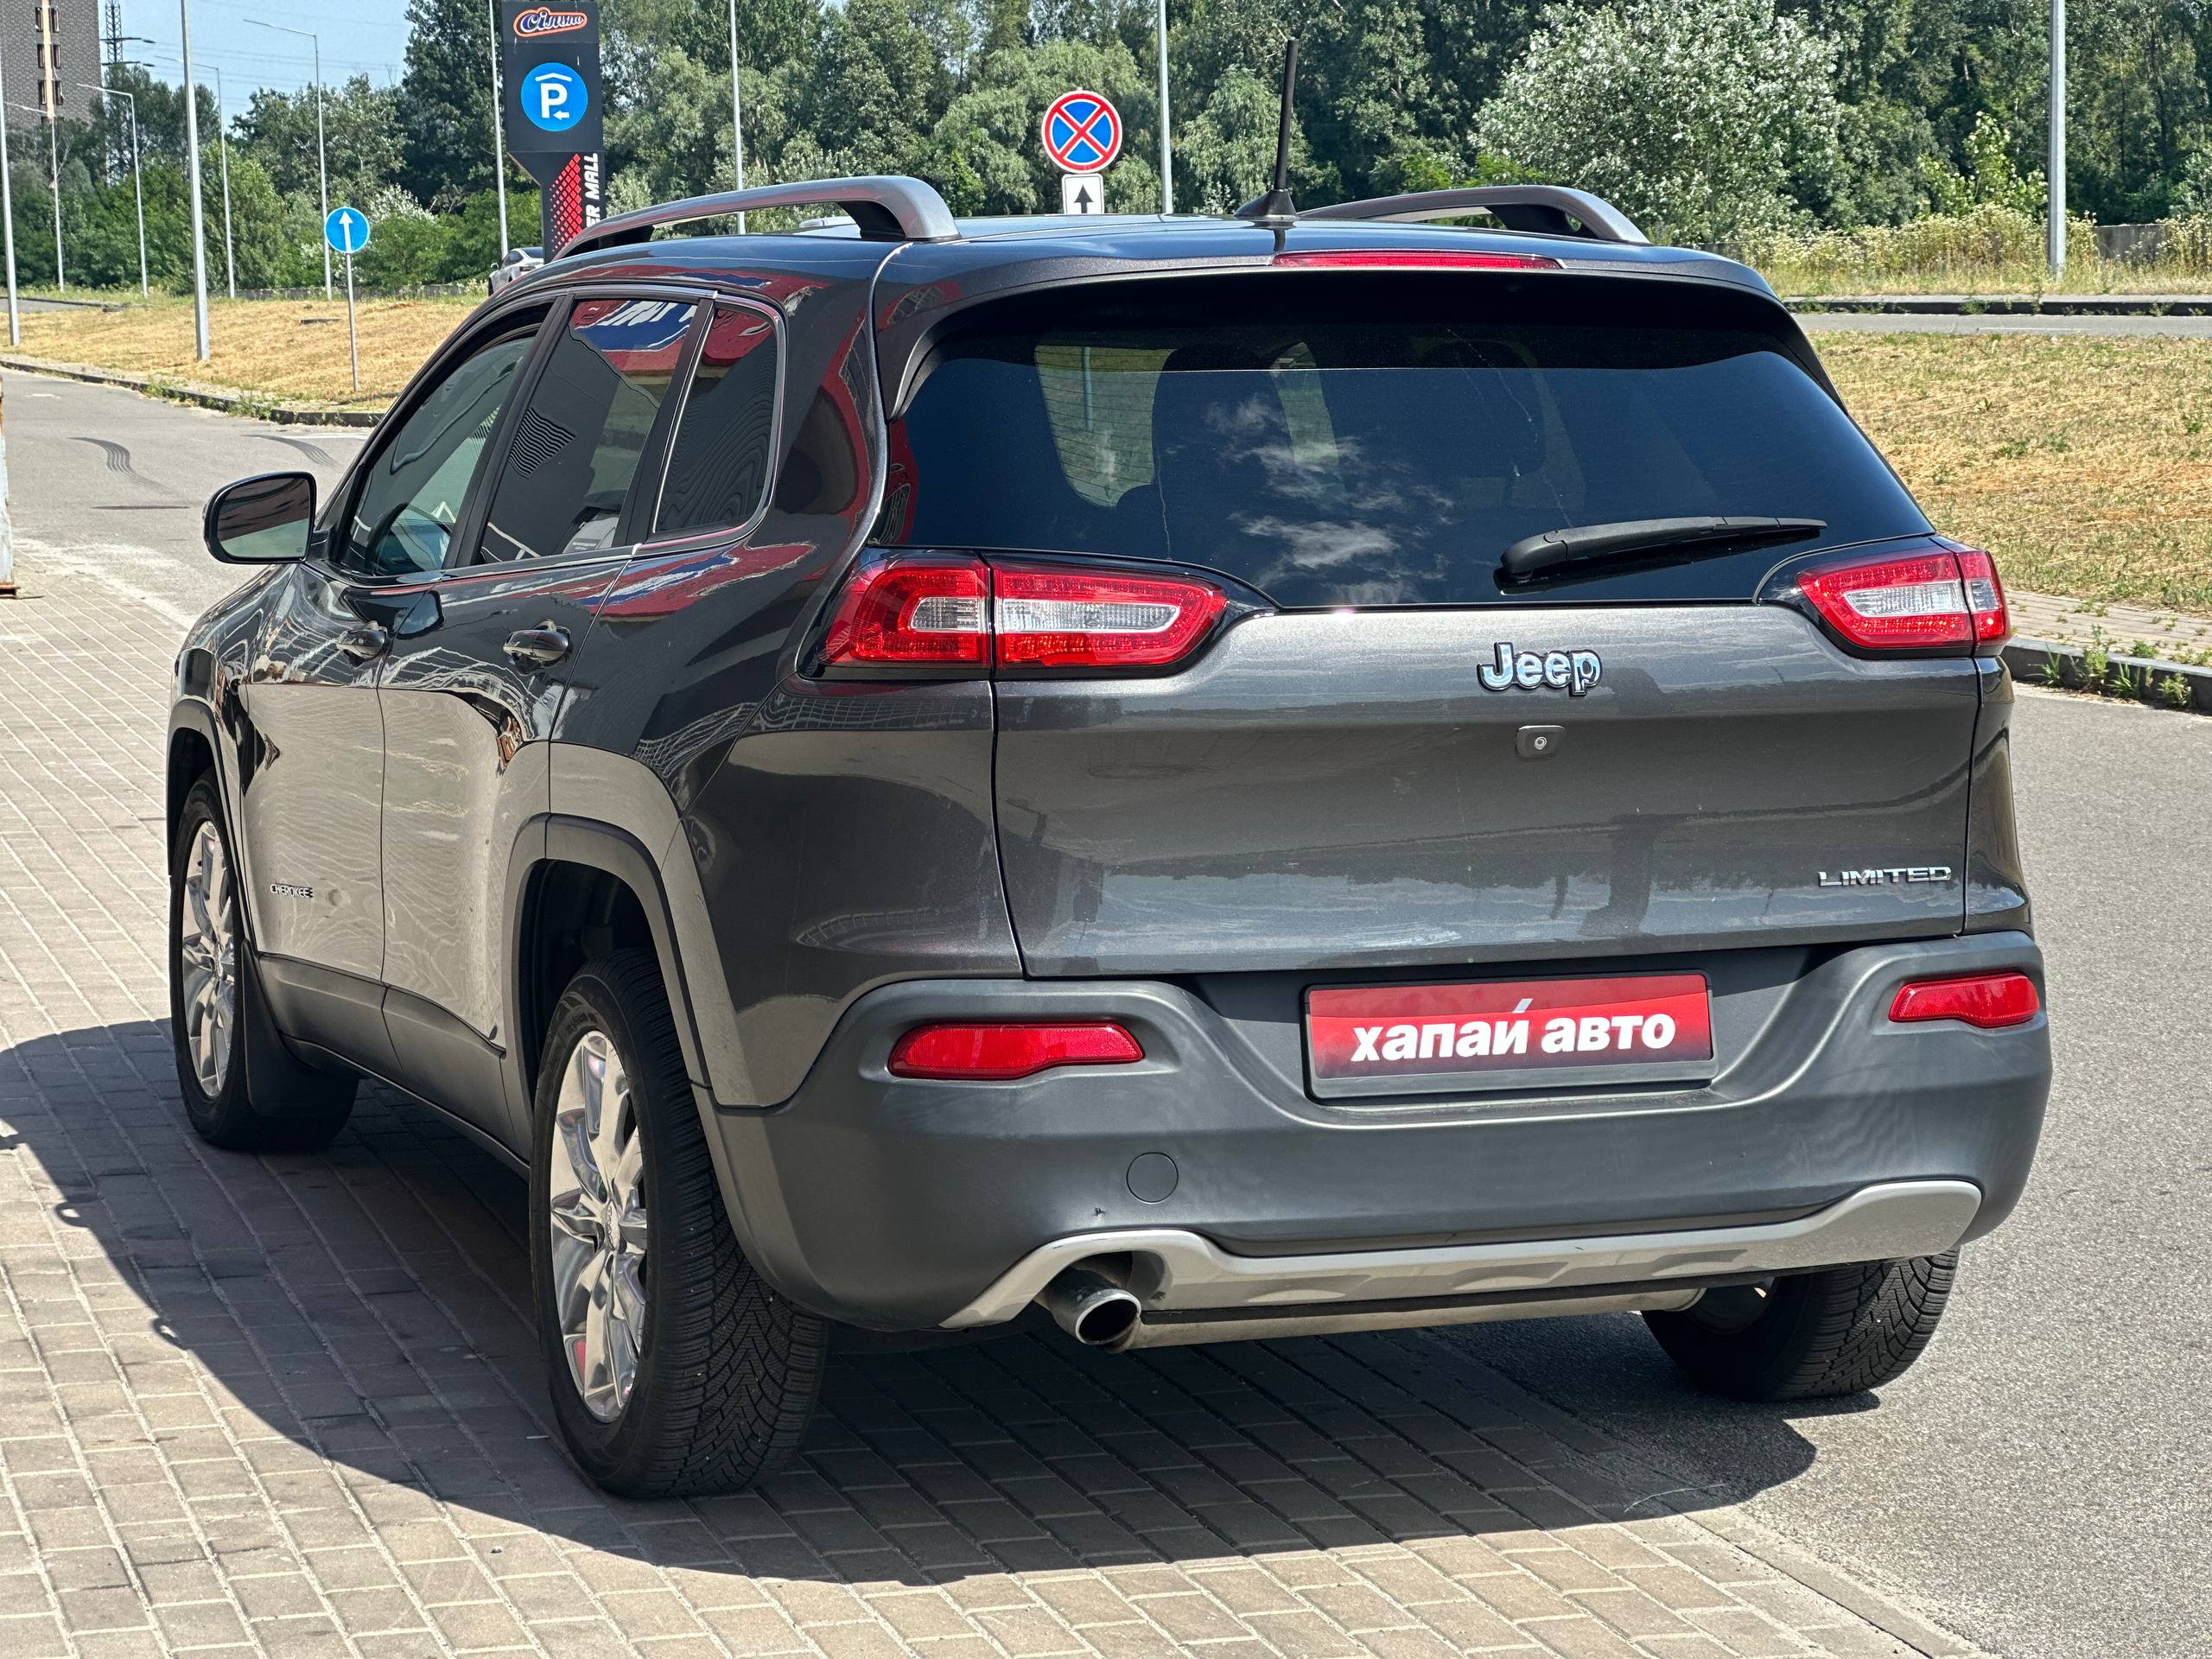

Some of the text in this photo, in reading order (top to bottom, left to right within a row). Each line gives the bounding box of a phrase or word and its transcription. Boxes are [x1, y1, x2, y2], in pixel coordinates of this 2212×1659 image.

[540, 83, 568, 118] P
[583, 152, 600, 200] MALL
[1477, 642, 1602, 696] Jeep
[270, 882, 313, 899] CHEROKEE
[1818, 867, 1952, 887] LIMITED
[1541, 1013, 1676, 1055] авто
